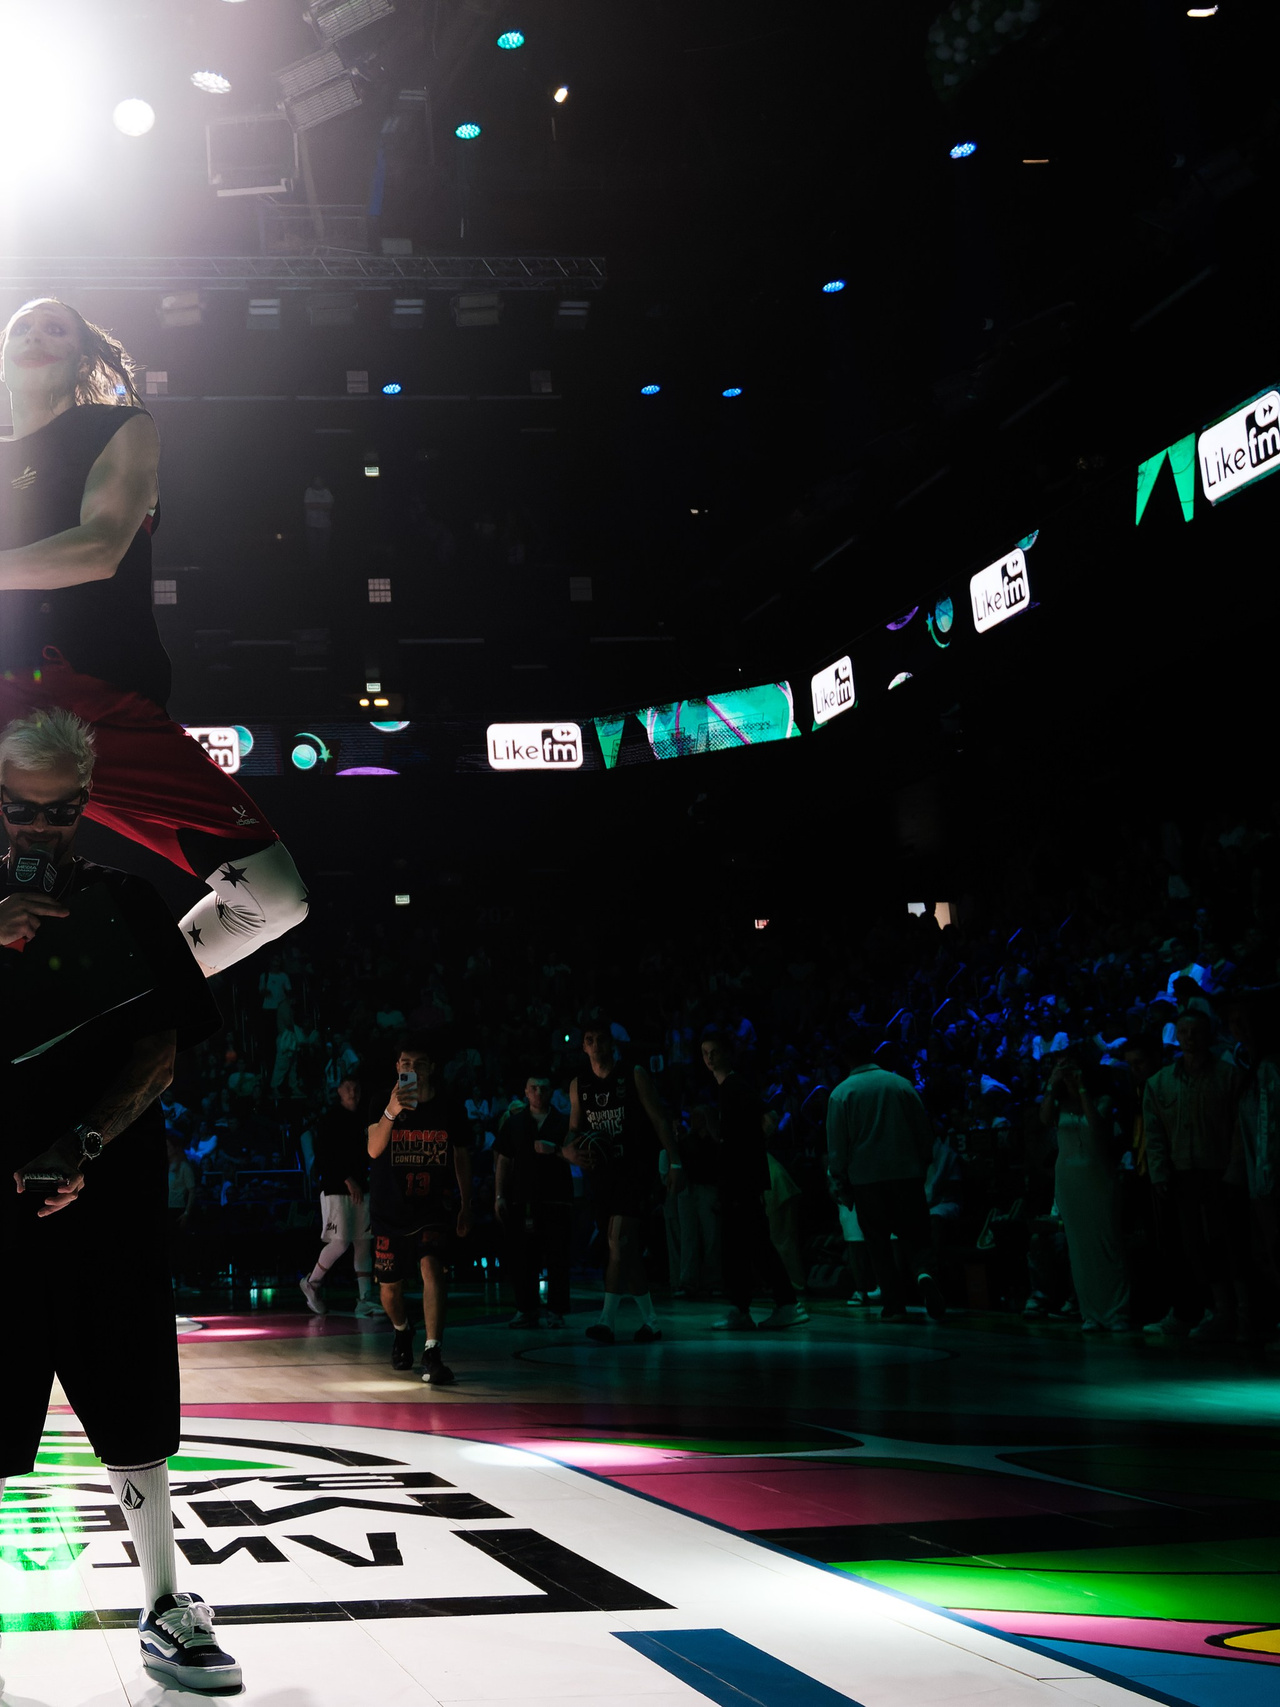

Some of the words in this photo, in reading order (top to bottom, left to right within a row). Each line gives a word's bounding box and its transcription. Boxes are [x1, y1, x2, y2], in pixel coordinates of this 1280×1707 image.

[1204, 446, 1246, 488] Like
[974, 589, 1002, 621] Like
[815, 688, 835, 714] Like
[492, 739, 539, 761] Like
[543, 738, 577, 762] fm
[391, 1129, 448, 1152] KICKS
[405, 1171, 431, 1197] 13
